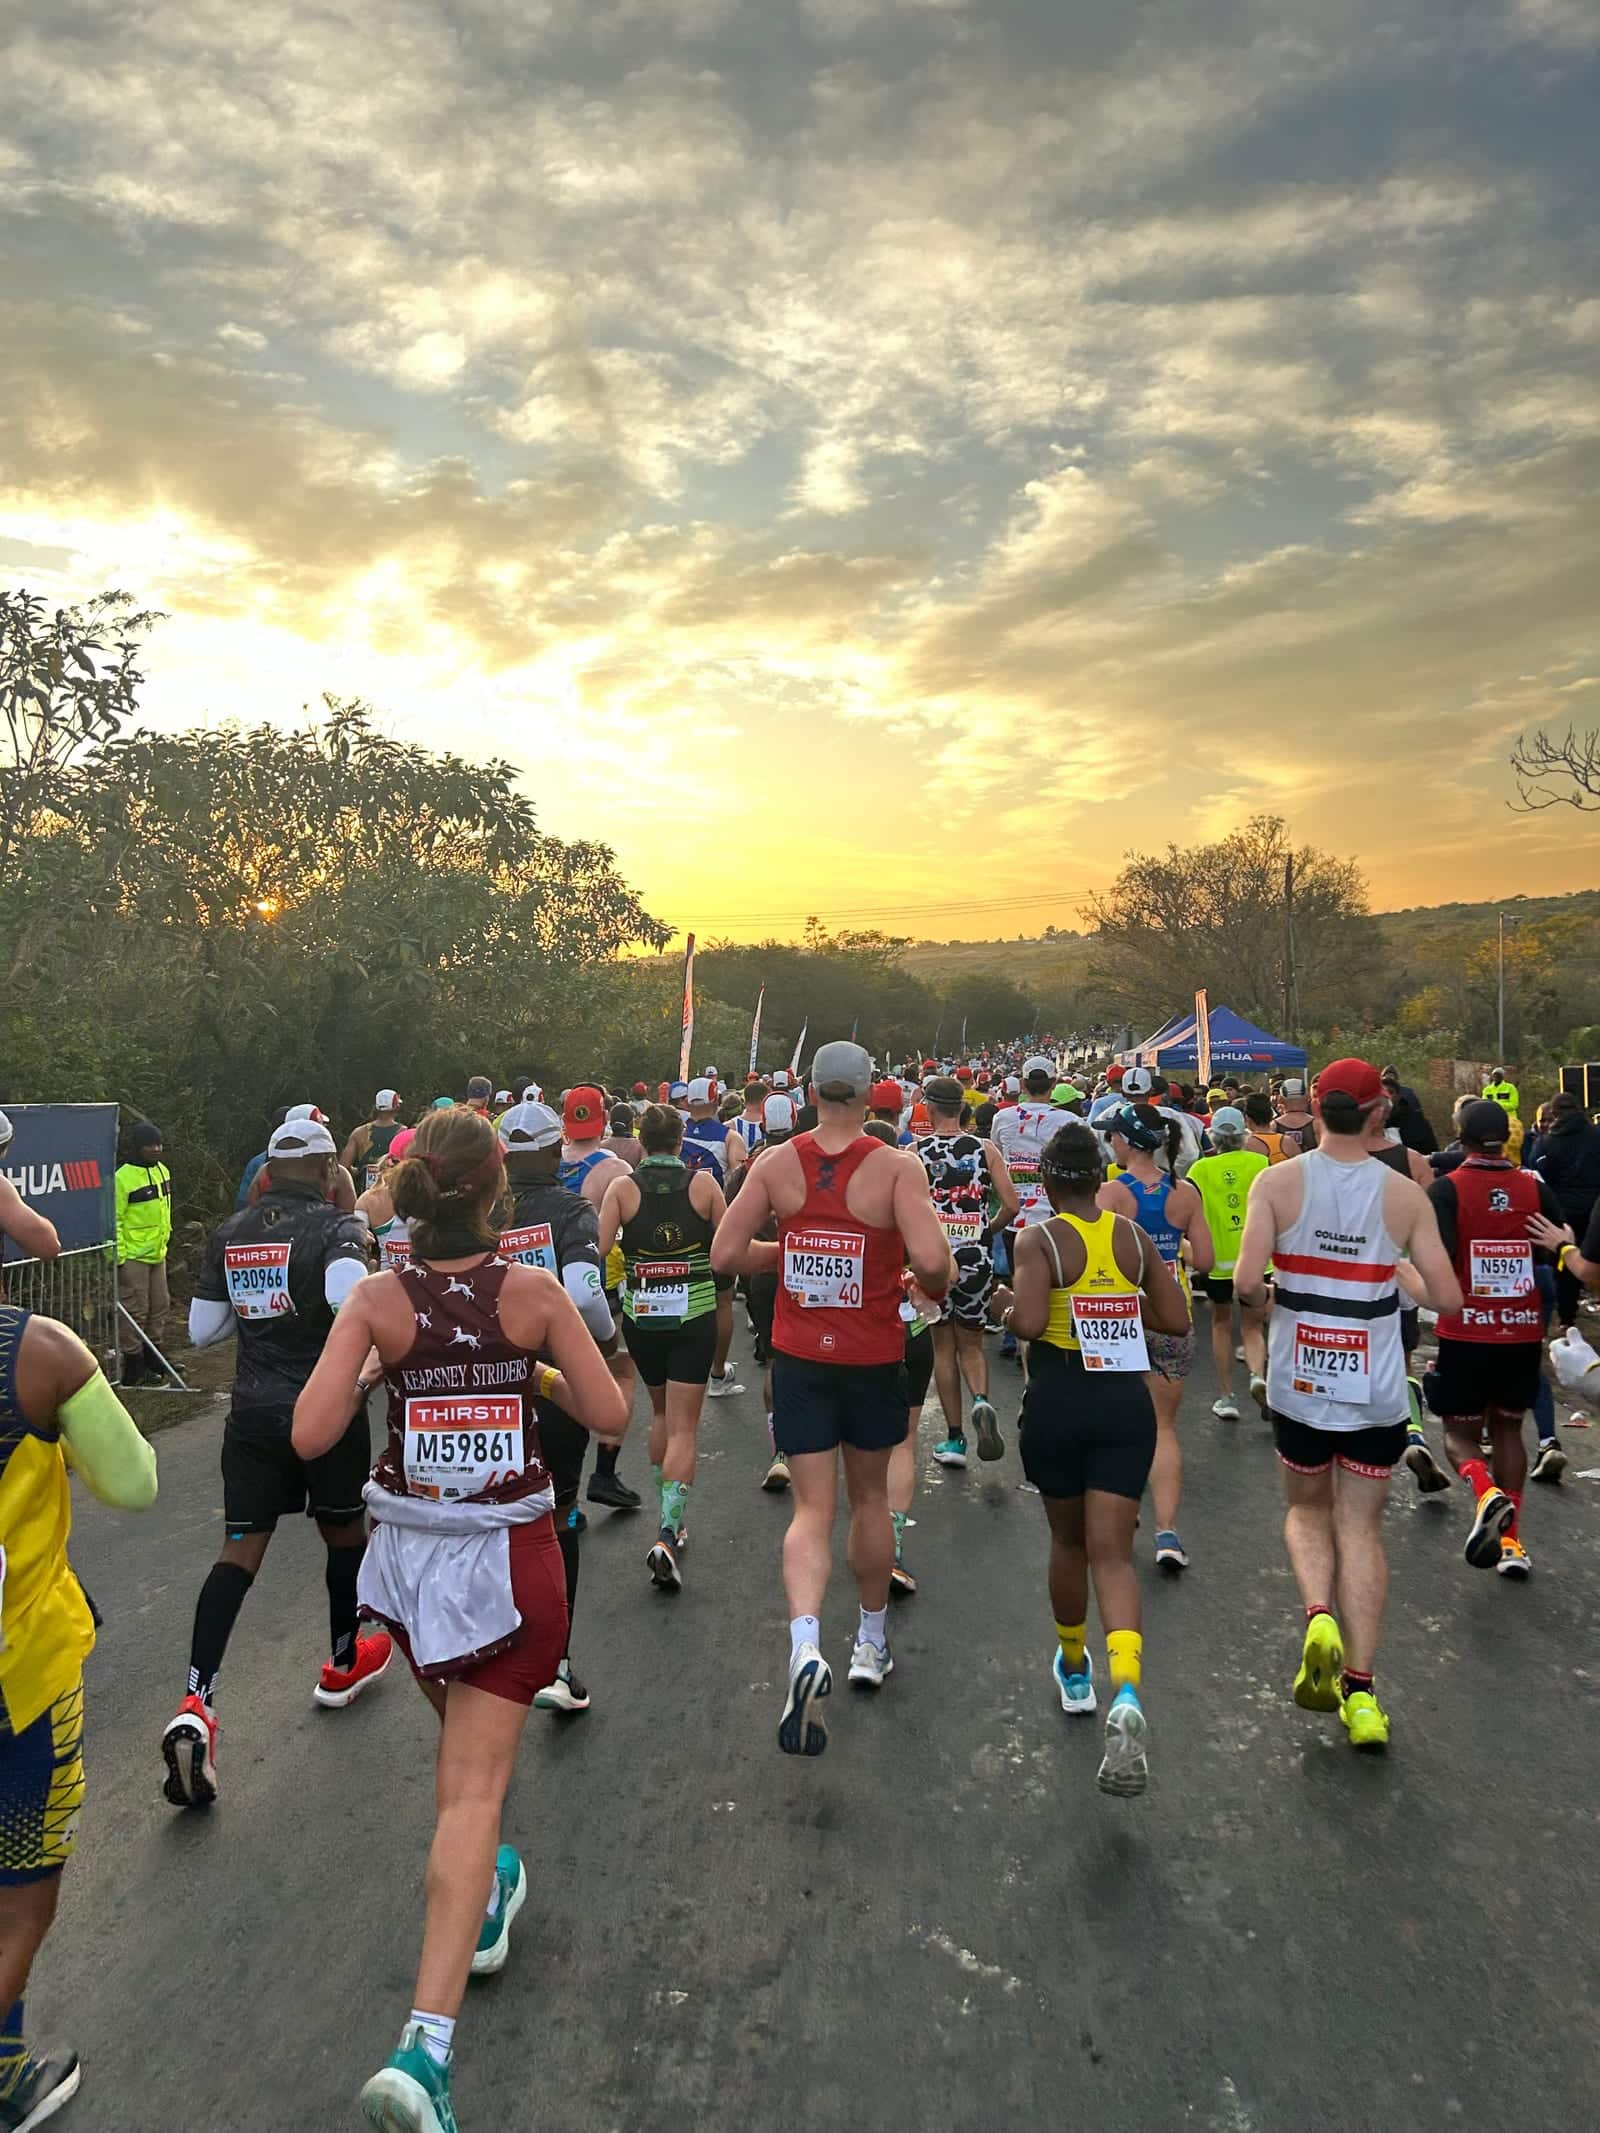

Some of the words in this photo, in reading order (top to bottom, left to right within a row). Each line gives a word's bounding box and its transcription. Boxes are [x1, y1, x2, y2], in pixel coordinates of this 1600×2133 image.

[1189, 1053, 1253, 1062] NSHUA
[0, 1163, 67, 1197] HUA
[946, 1223, 976, 1237] 16497
[792, 1236, 857, 1251] THIRSTI
[1476, 1245, 1526, 1254] THIRSTI
[228, 1250, 283, 1263] THIRSTI
[639, 1266, 685, 1274] THIRSTI
[792, 1254, 853, 1278] M25653
[1481, 1259, 1523, 1274] N5967
[231, 1268, 283, 1290] P30966
[1513, 1278, 1532, 1293] 40
[838, 1282, 860, 1304] 40
[270, 1292, 291, 1312] 40
[1076, 1302, 1135, 1312] THIRSTI
[1462, 1308, 1496, 1324] Fat
[1501, 1308, 1539, 1324] Cats
[1081, 1320, 1138, 1340] Q38246
[1299, 1328, 1363, 1345] THIRSTI
[1303, 1347, 1359, 1372] M7273
[401, 1364, 467, 1390] KEARSNEY
[472, 1357, 528, 1386] STRIDERS
[416, 1405, 513, 1422] THIRSTI
[416, 1432, 513, 1463] M59861
